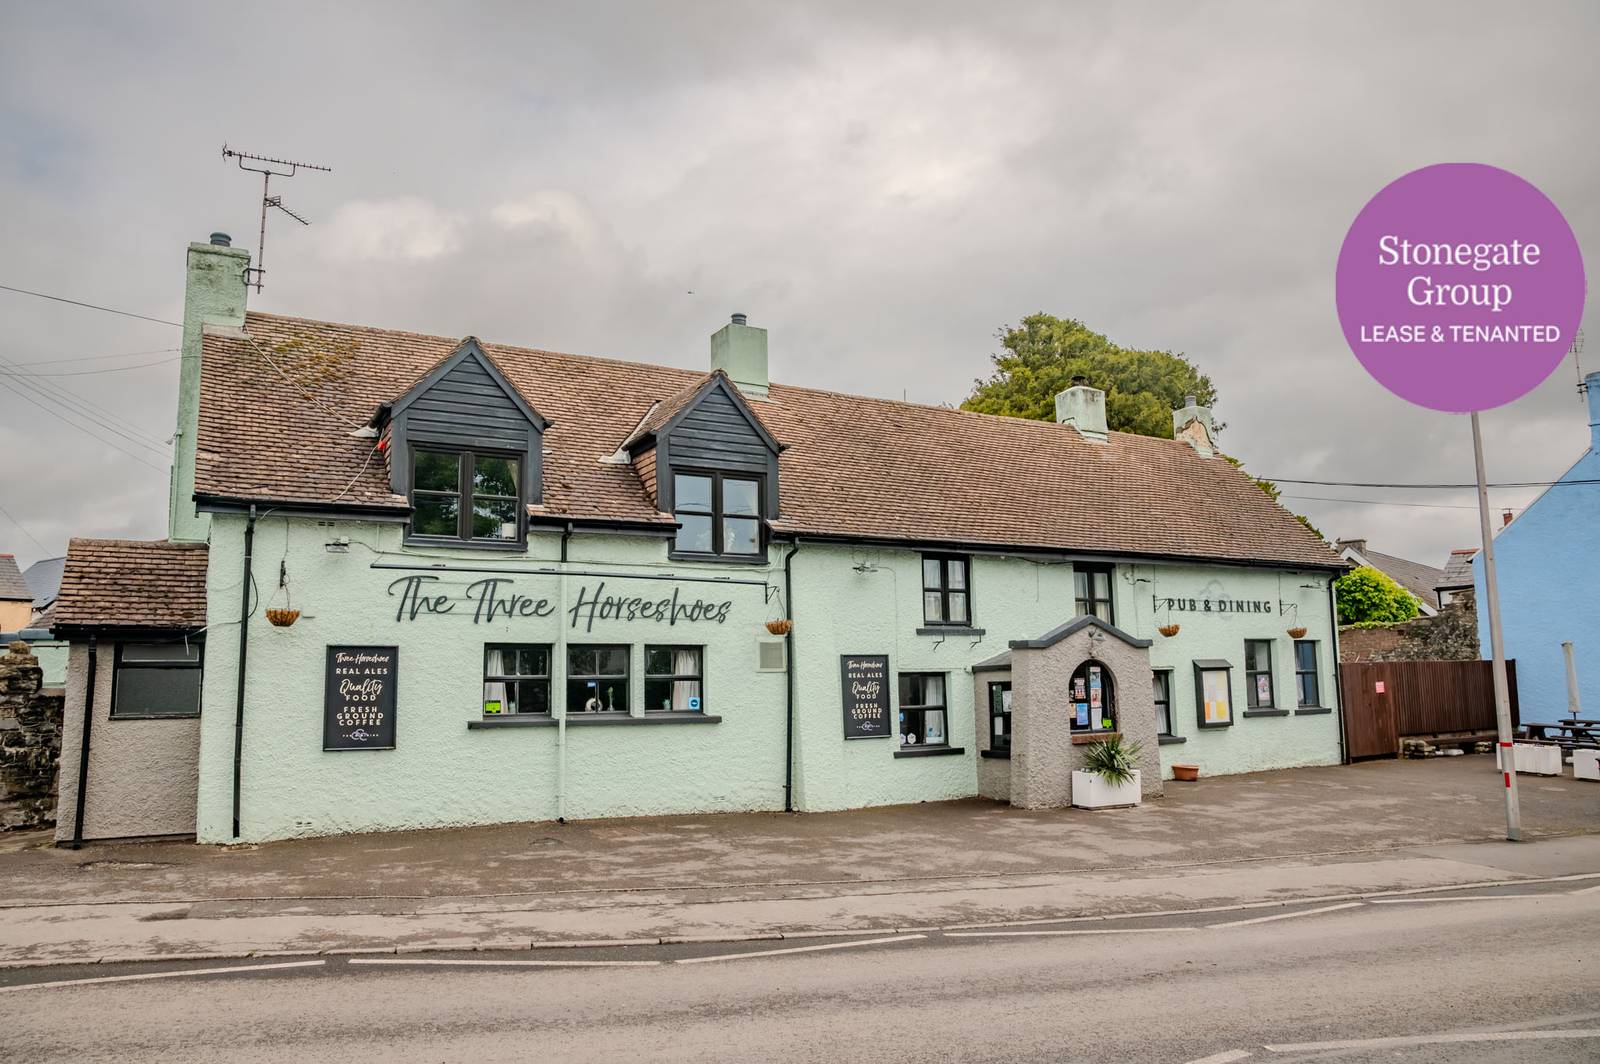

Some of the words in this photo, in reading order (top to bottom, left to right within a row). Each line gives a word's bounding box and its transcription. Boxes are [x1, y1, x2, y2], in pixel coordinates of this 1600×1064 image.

[387, 575, 456, 623] The
[465, 578, 556, 625] Three
[568, 582, 732, 633] Horseshoes
[1168, 598, 1196, 612] PUB
[1203, 599, 1212, 612] &
[1218, 600, 1272, 613] DINING
[340, 679, 382, 696] Quality
[852, 681, 880, 695] Quality
